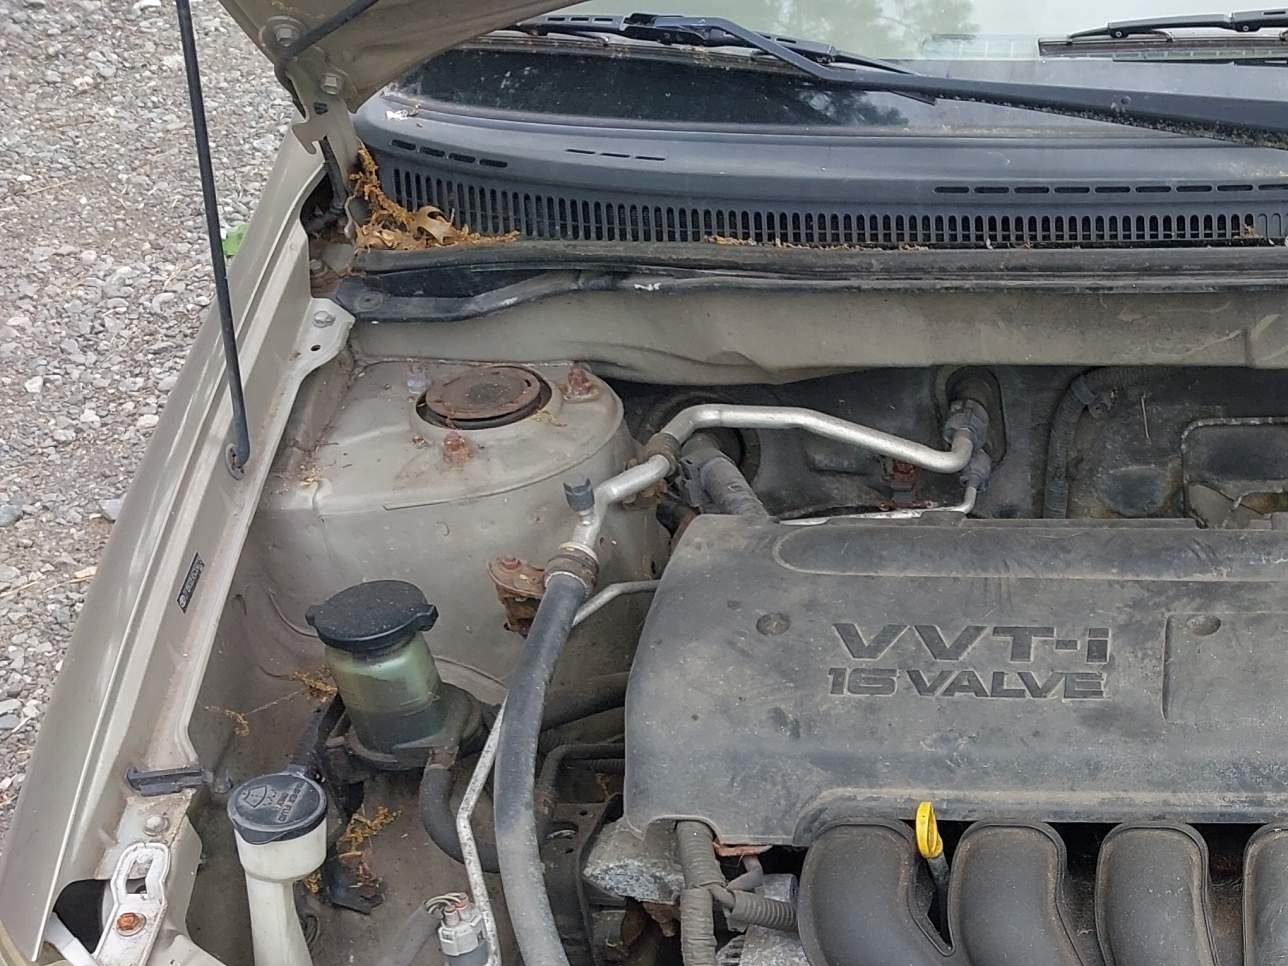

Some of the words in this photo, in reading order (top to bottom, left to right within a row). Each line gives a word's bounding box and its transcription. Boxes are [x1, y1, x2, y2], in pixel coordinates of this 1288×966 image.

[833, 622, 1111, 663] VVT-i
[828, 667, 899, 696] 16
[906, 669, 1108, 699] VALVE
